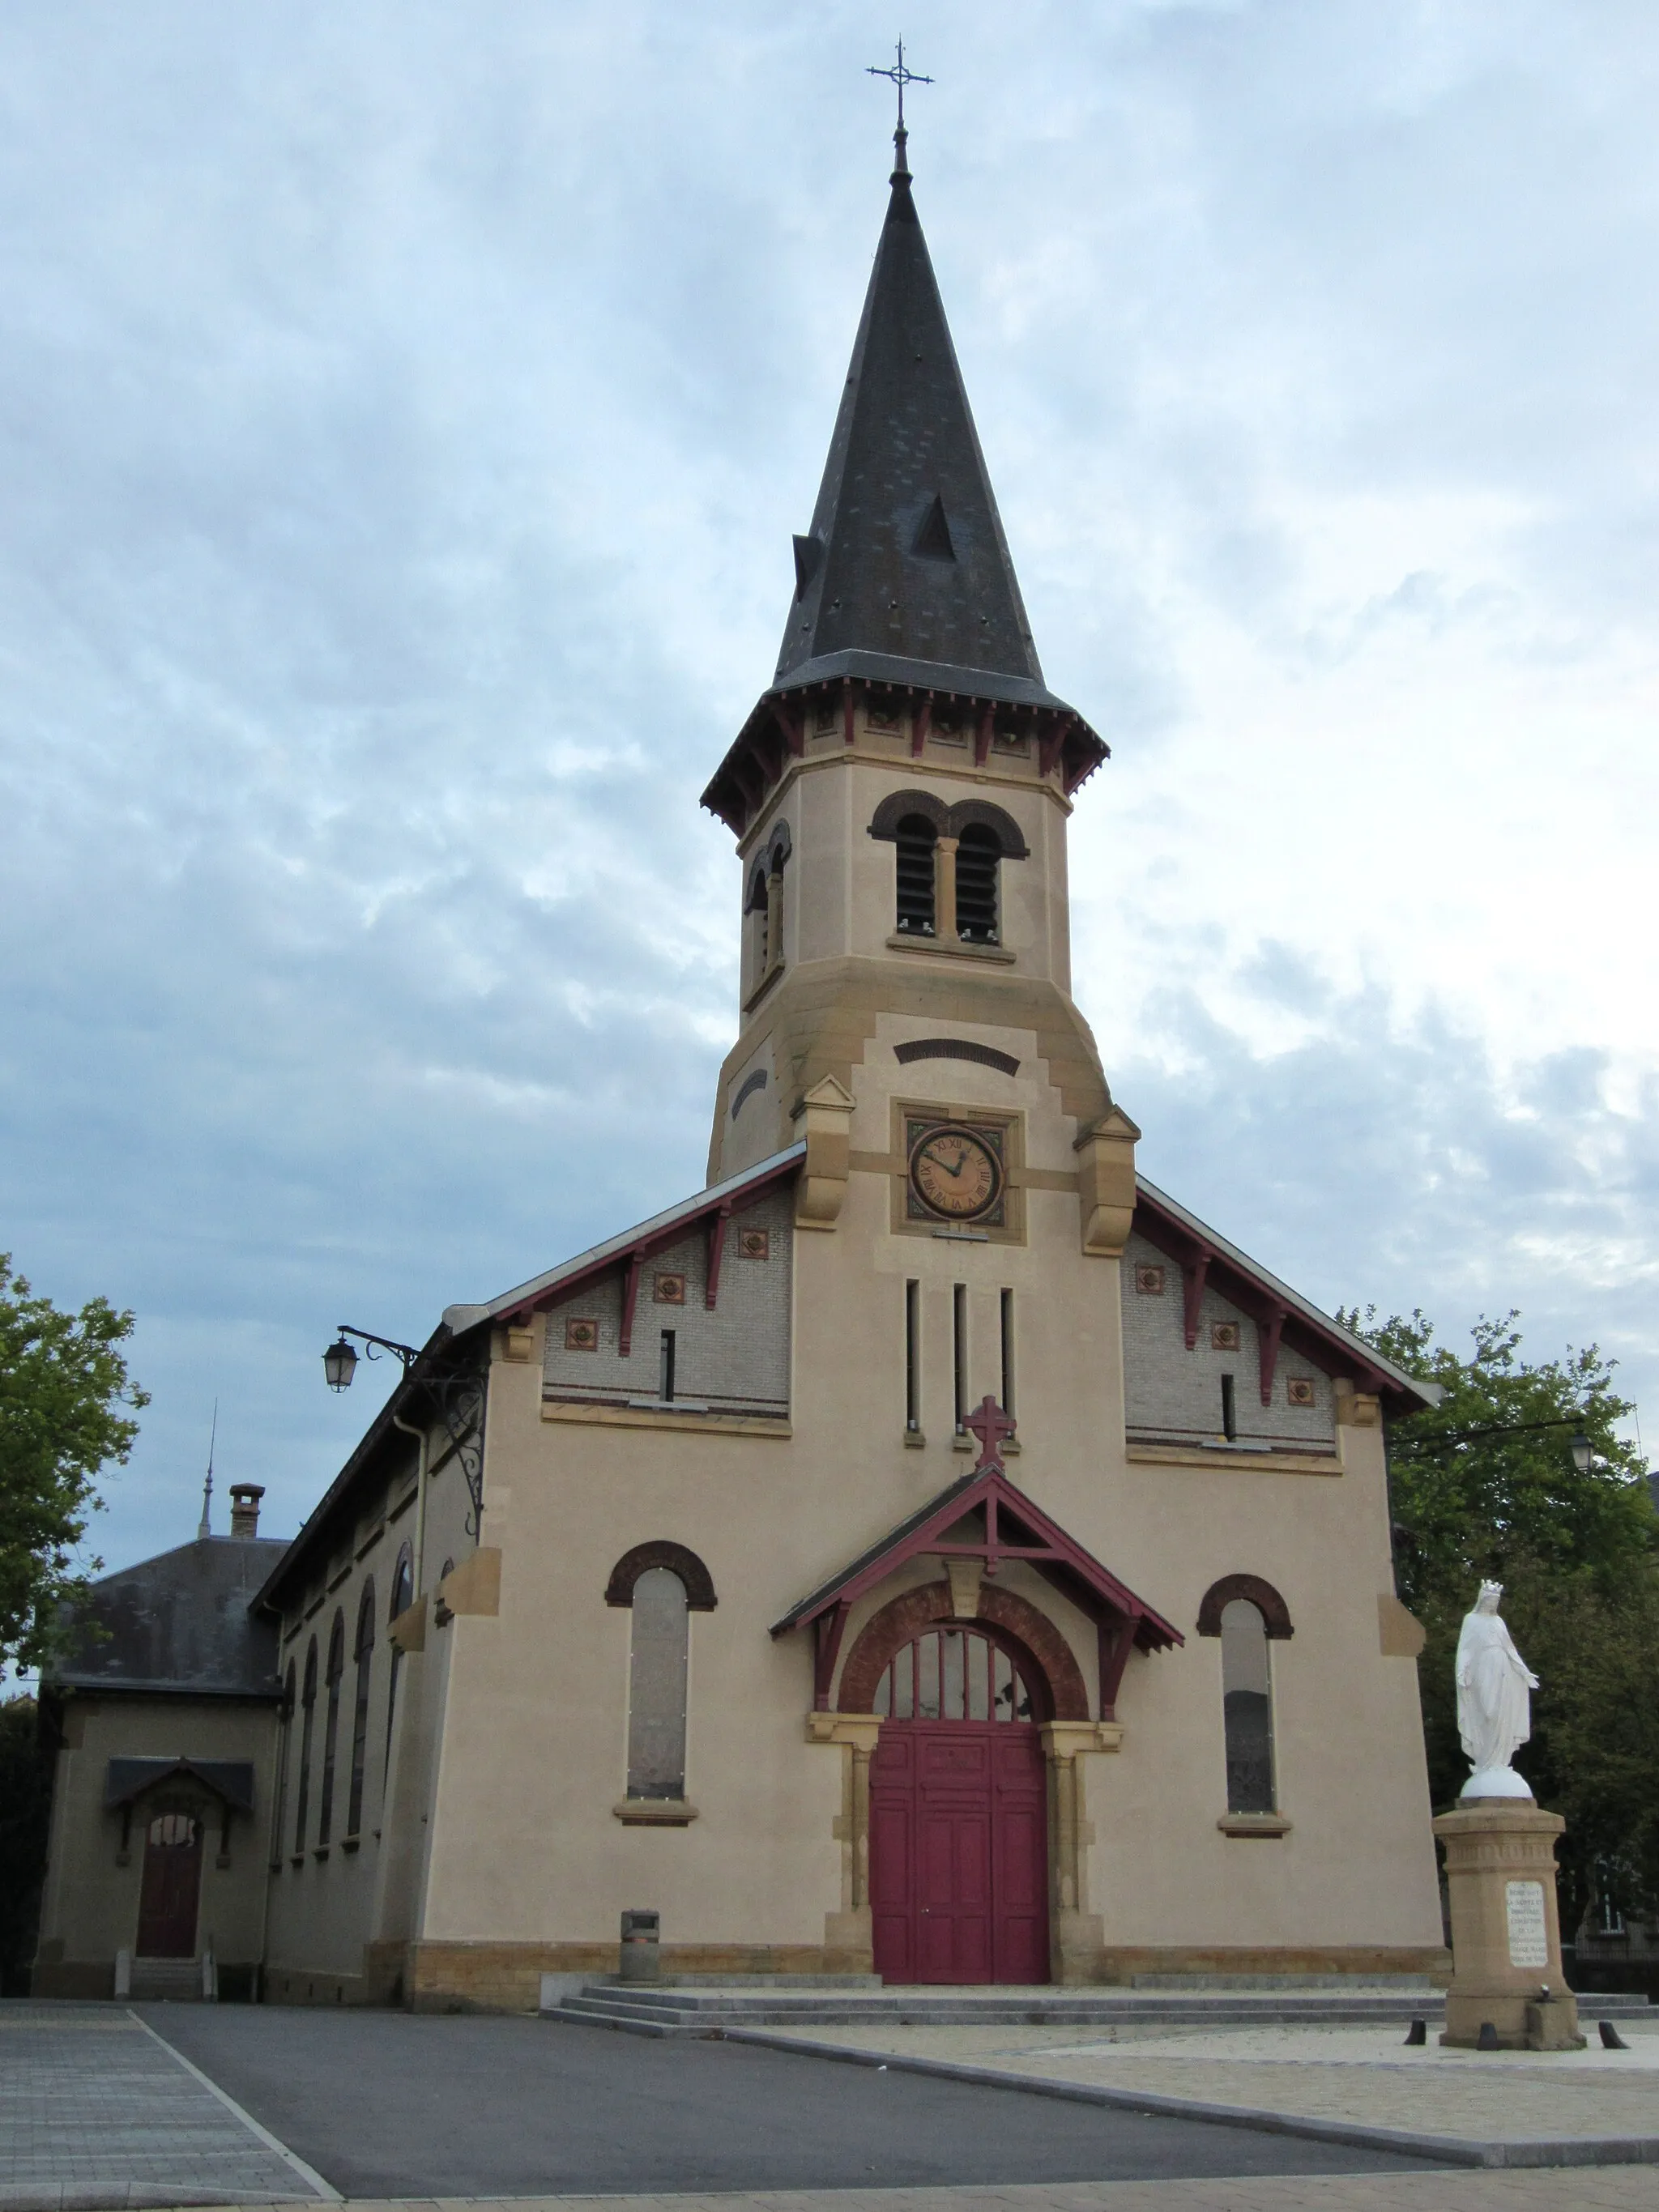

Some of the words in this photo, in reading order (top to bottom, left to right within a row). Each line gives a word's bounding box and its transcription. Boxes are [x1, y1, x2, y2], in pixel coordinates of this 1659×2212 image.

[934, 1140, 946, 1152] XI
[949, 1139, 962, 1149] XII
[975, 1157, 987, 1166] II
[920, 1165, 932, 1176] IX
[980, 1171, 990, 1183] III
[923, 1179, 936, 1193] VIII
[933, 1191, 946, 1206] VII
[952, 1199, 962, 1209] VI
[968, 1198, 976, 1208] V
